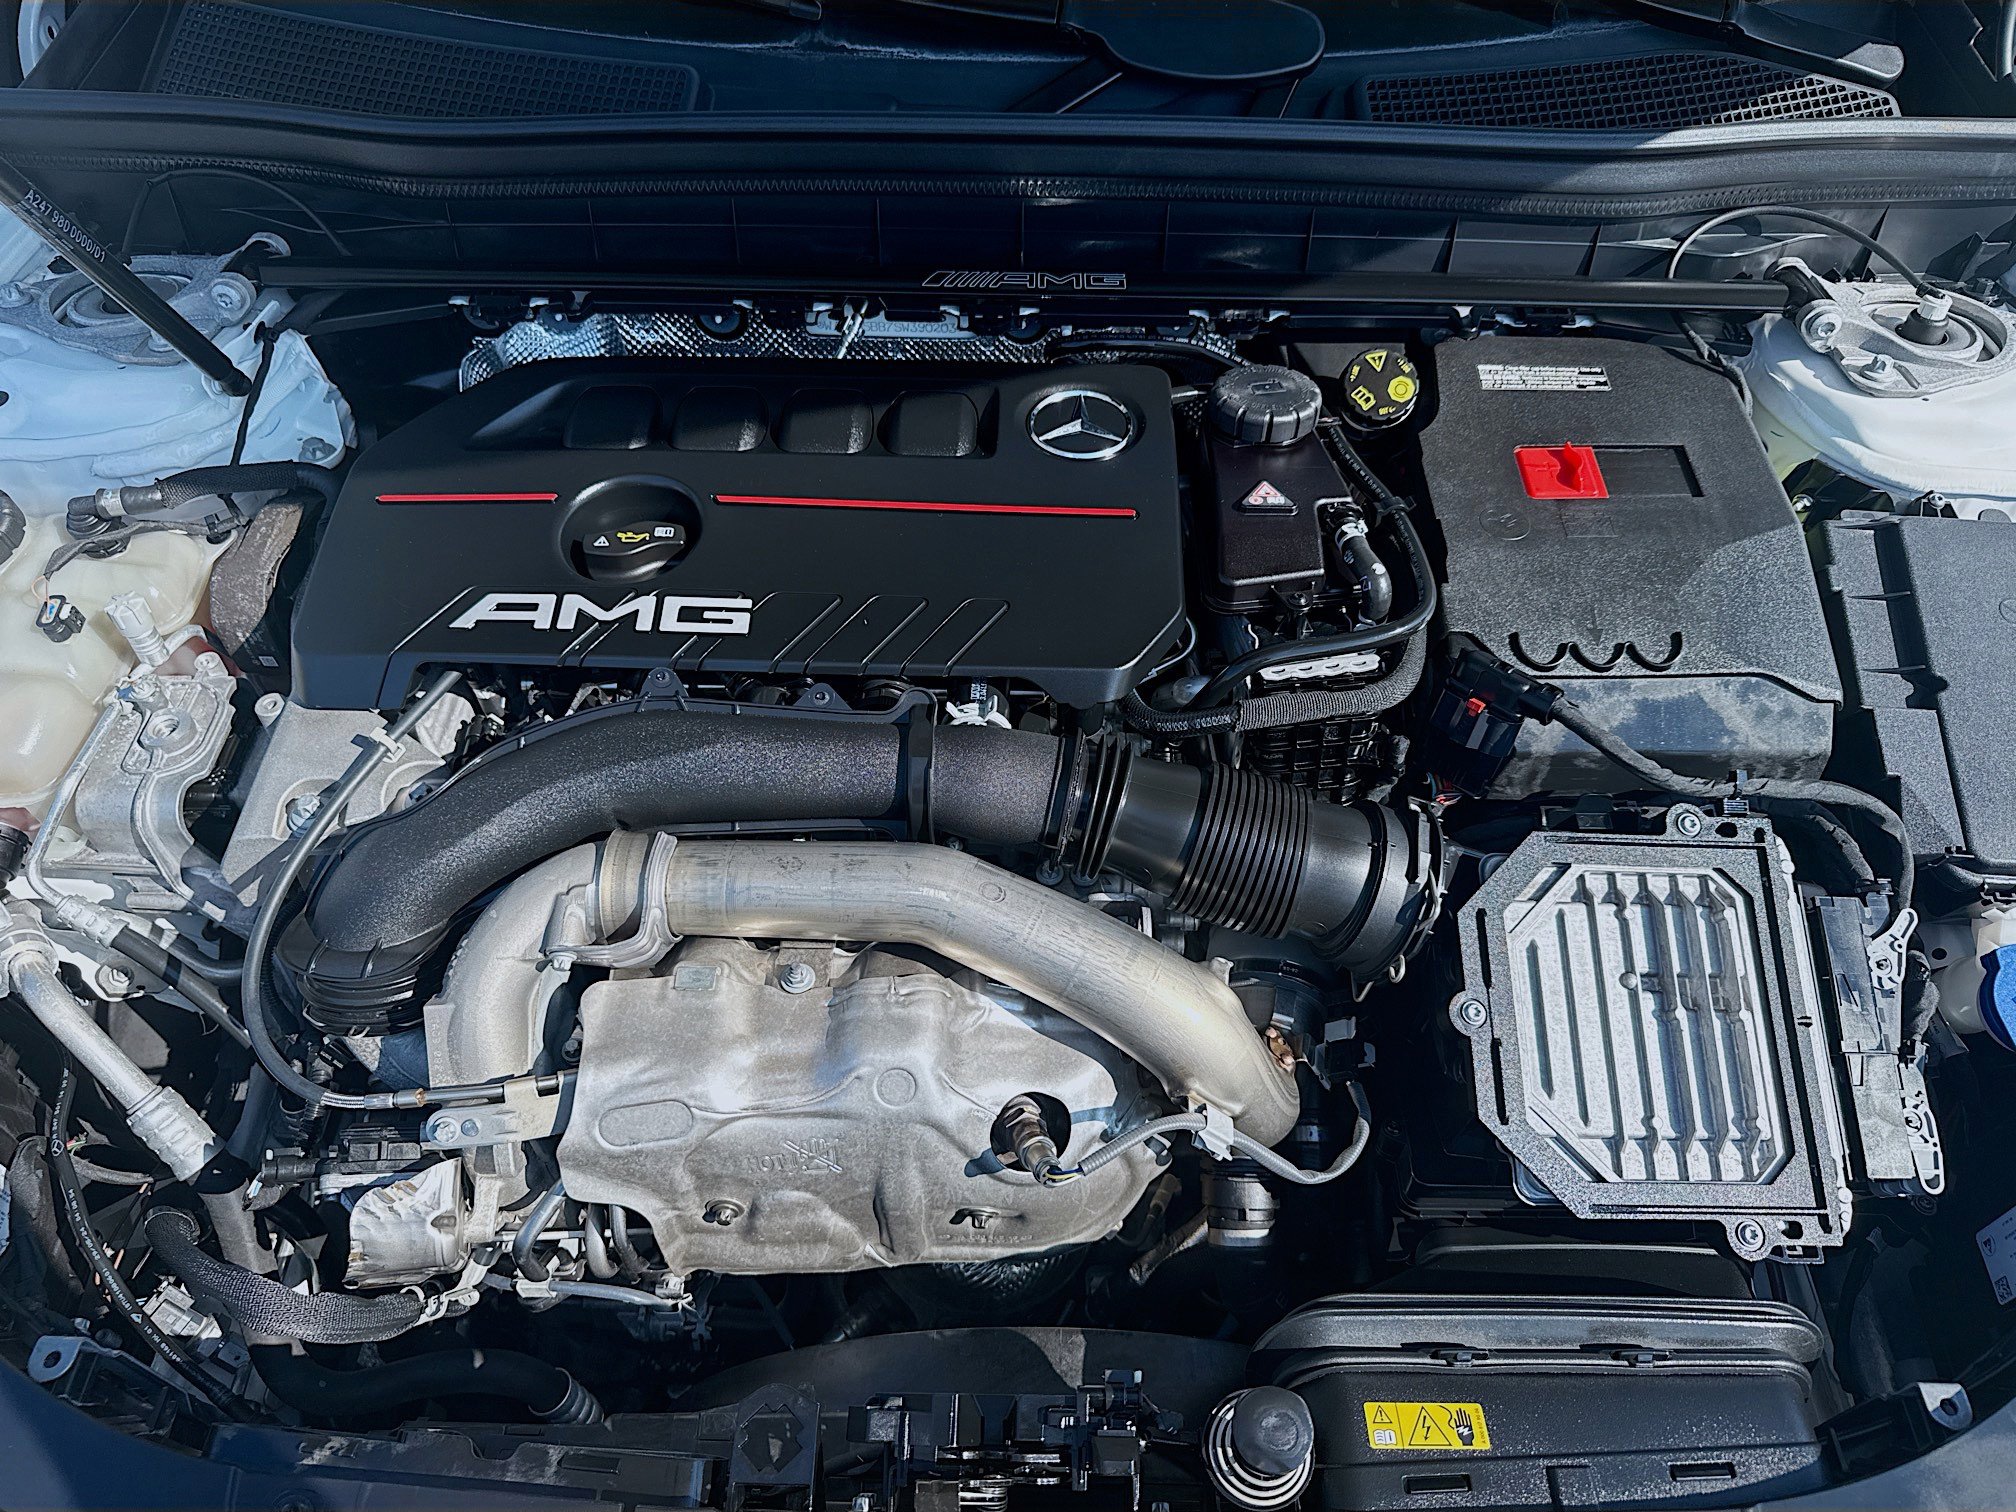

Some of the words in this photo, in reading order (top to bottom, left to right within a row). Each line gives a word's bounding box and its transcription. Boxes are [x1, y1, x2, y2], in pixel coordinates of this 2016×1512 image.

[25, 189, 52, 216] A247
[52, 210, 71, 232] 980
[70, 225, 106, 263] 0000/01
[988, 271, 1127, 289] AMG
[448, 593, 753, 635] AMG
